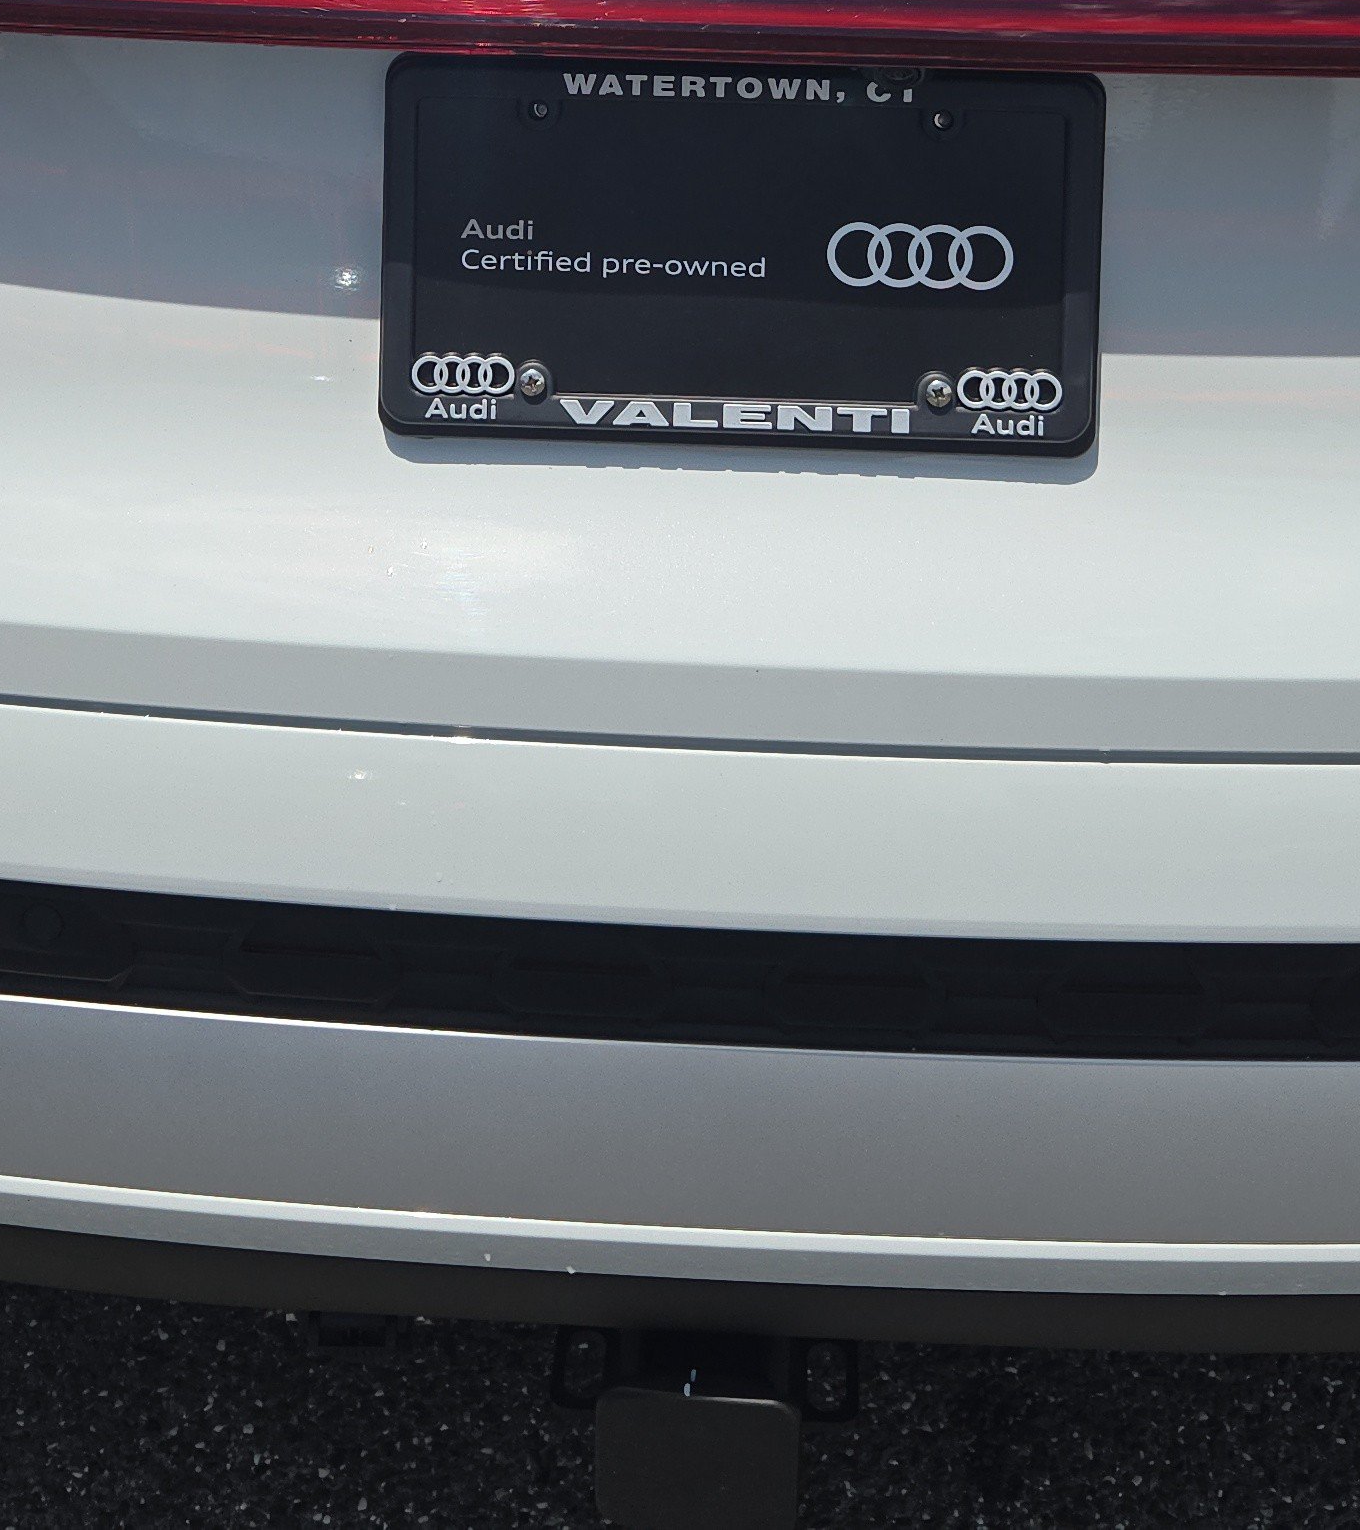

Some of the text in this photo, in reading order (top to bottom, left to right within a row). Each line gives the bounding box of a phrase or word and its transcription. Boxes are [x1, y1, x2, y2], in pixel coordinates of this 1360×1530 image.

[562, 73, 845, 104] WATERTOWN,
[460, 218, 534, 241] Audi
[460, 248, 766, 279] Certified pre-owned
[424, 397, 497, 421] Audi
[559, 399, 910, 435] VALENTI
[970, 412, 1045, 437] Audi
